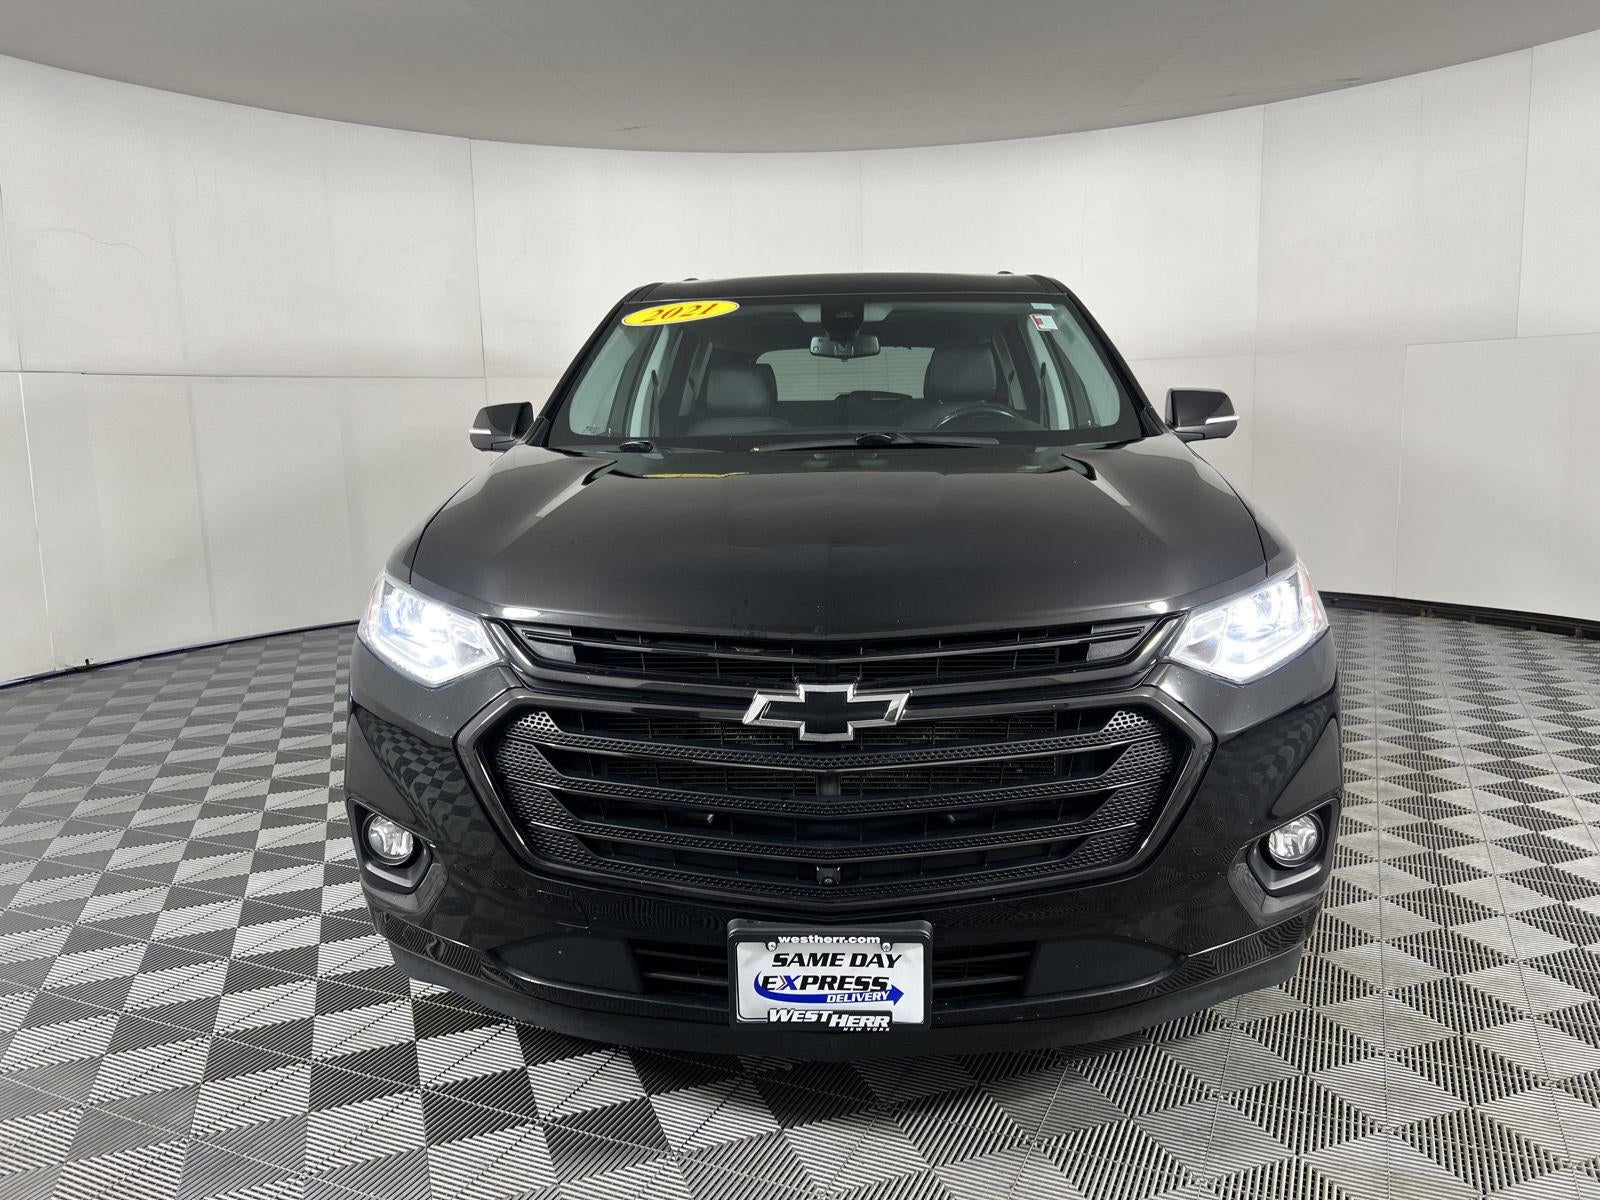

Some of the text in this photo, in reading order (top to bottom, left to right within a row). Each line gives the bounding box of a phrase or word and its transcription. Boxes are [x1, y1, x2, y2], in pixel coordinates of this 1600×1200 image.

[641, 303, 718, 322] 2021
[777, 935, 881, 944] westherr.com
[772, 952, 902, 968] SAME DAY
[761, 975, 890, 991] EXPRESS
[826, 991, 890, 1004] DELIVERY
